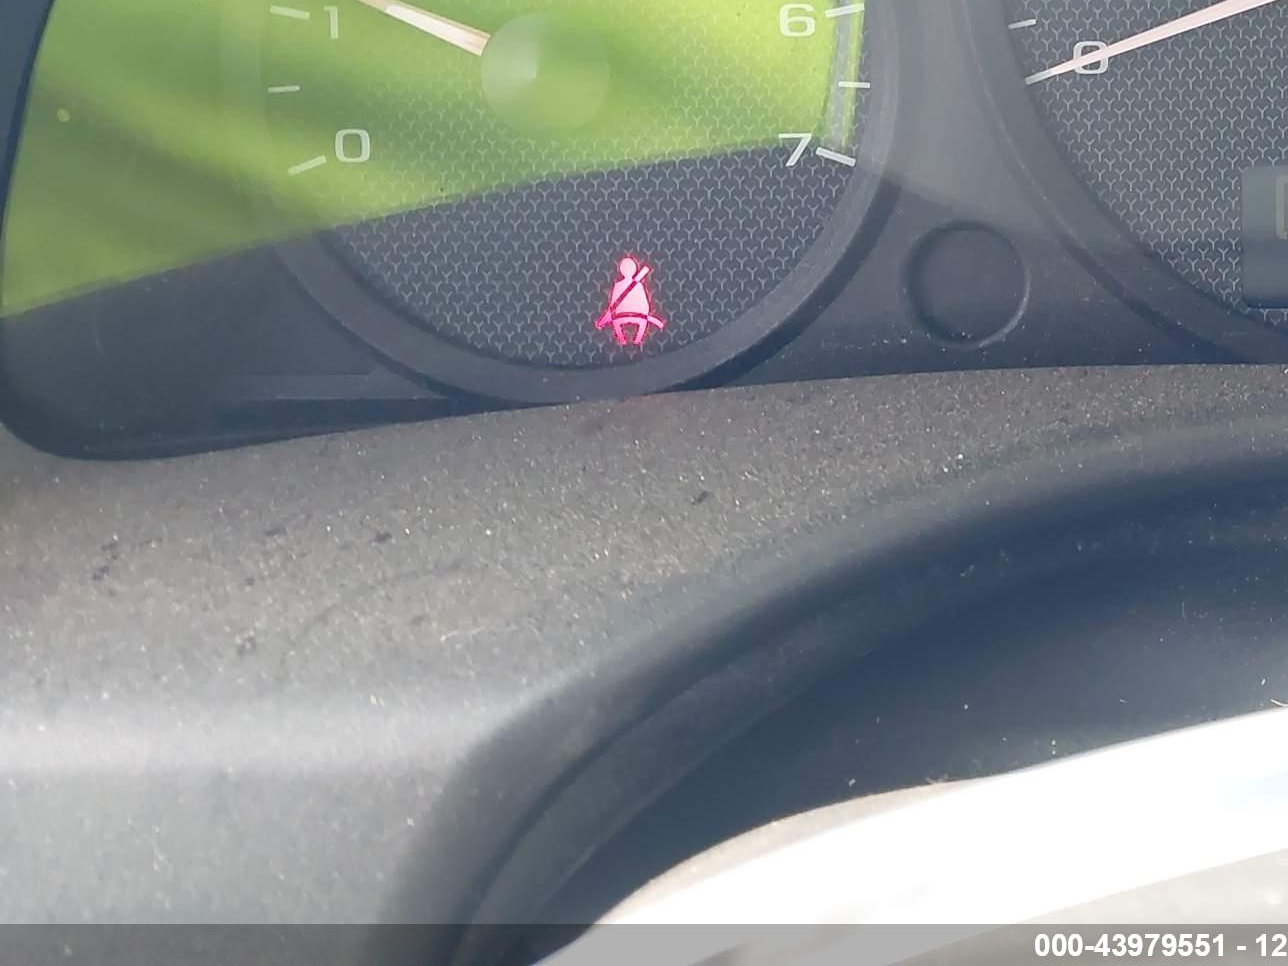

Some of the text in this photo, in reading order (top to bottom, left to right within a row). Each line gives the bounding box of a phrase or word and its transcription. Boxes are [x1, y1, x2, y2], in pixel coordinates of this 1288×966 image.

[323, 6, 339, 39] 1
[779, 3, 816, 38] 6
[1073, 40, 1109, 75] 0
[335, 129, 371, 163] 0
[778, 132, 812, 166] 7
